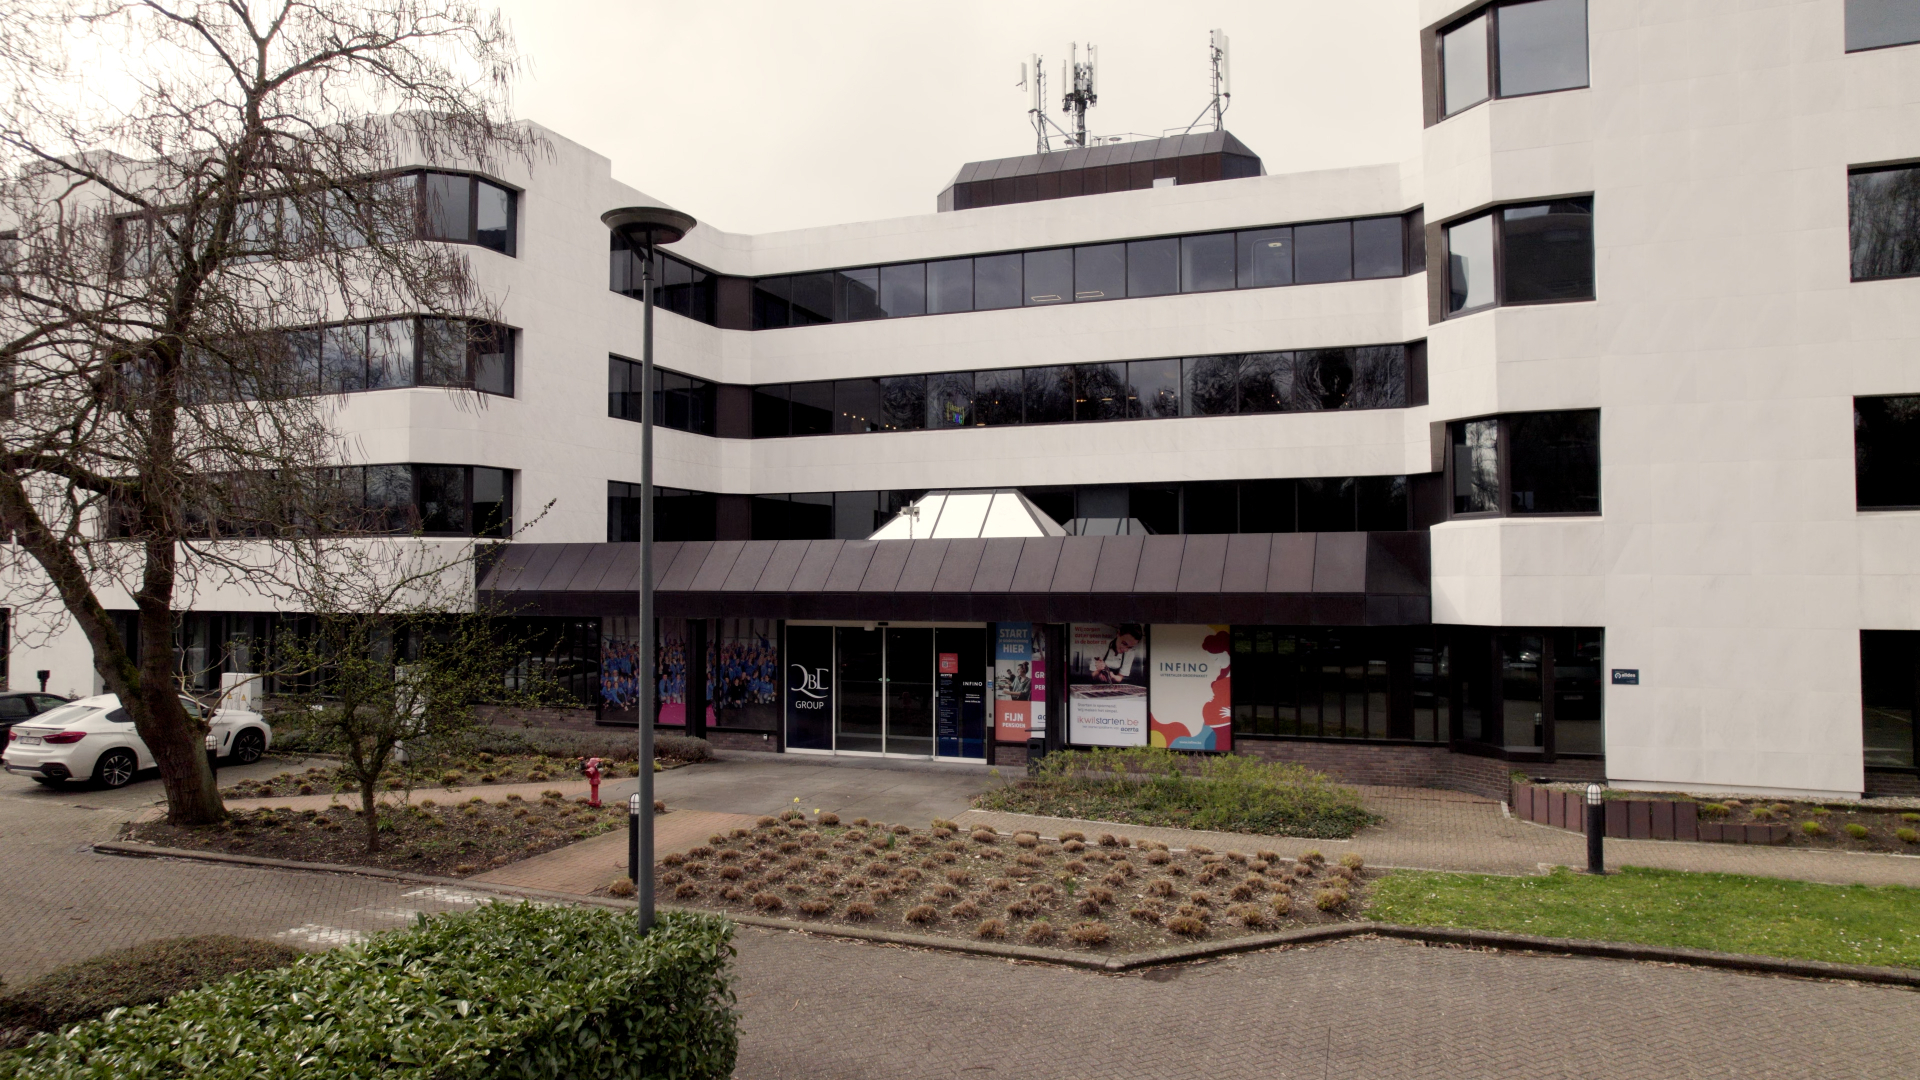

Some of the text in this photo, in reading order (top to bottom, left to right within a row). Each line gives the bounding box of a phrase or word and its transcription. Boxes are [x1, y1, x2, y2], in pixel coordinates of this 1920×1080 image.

[999, 629, 1028, 638] START
[1003, 644, 1024, 653] HIER
[1160, 663, 1208, 672] INFINO
[795, 701, 824, 709] GROUP
[1004, 713, 1023, 721] FIJN
[1077, 716, 1139, 725] ikwilstarten.be
